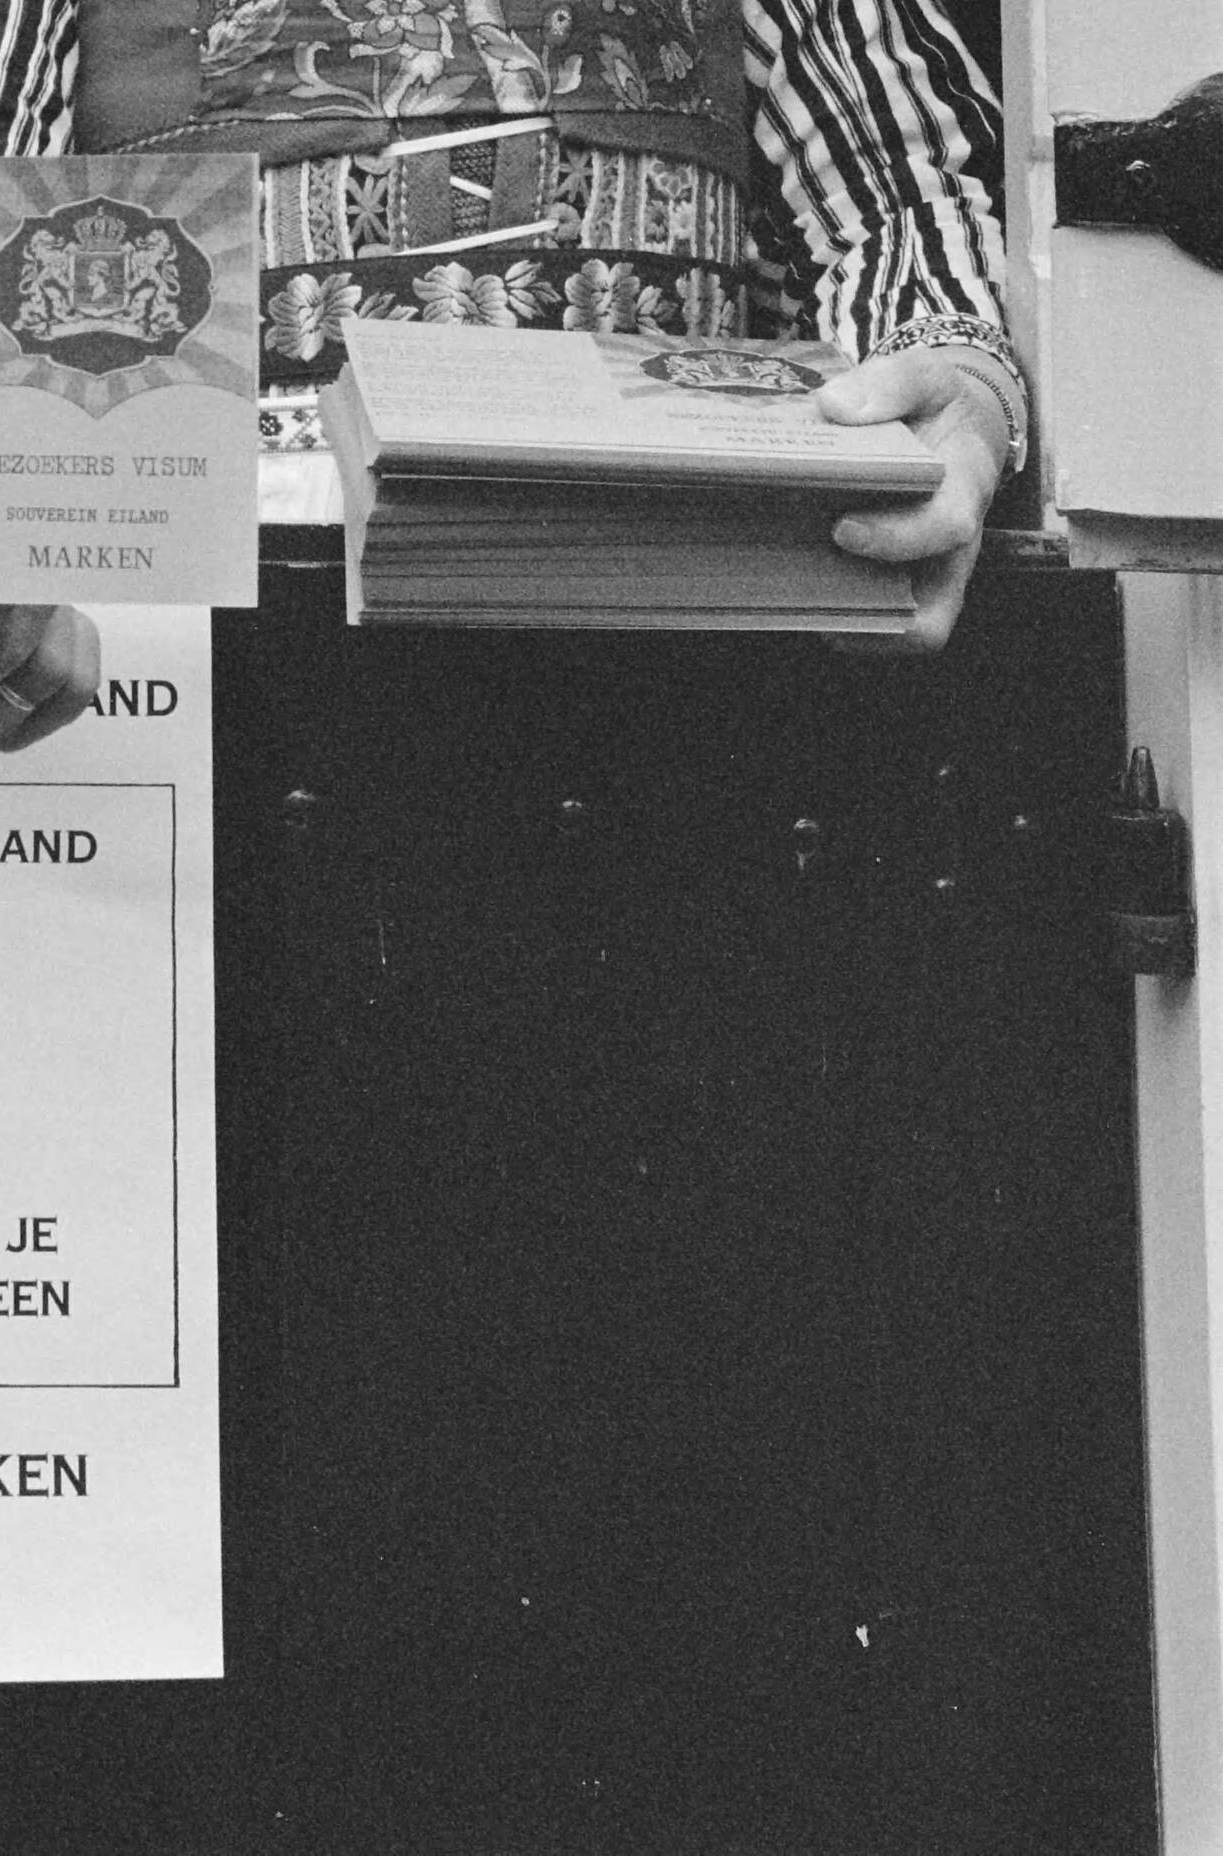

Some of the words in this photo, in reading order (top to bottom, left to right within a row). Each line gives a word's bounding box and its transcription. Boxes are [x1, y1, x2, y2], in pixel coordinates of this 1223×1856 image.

[132, 457, 206, 476] VISUM
[7, 507, 97, 522] SOUVEREIN
[108, 509, 168, 524] EILAND
[29, 546, 152, 569] MARKEN
[6, 1218, 57, 1252] JE
